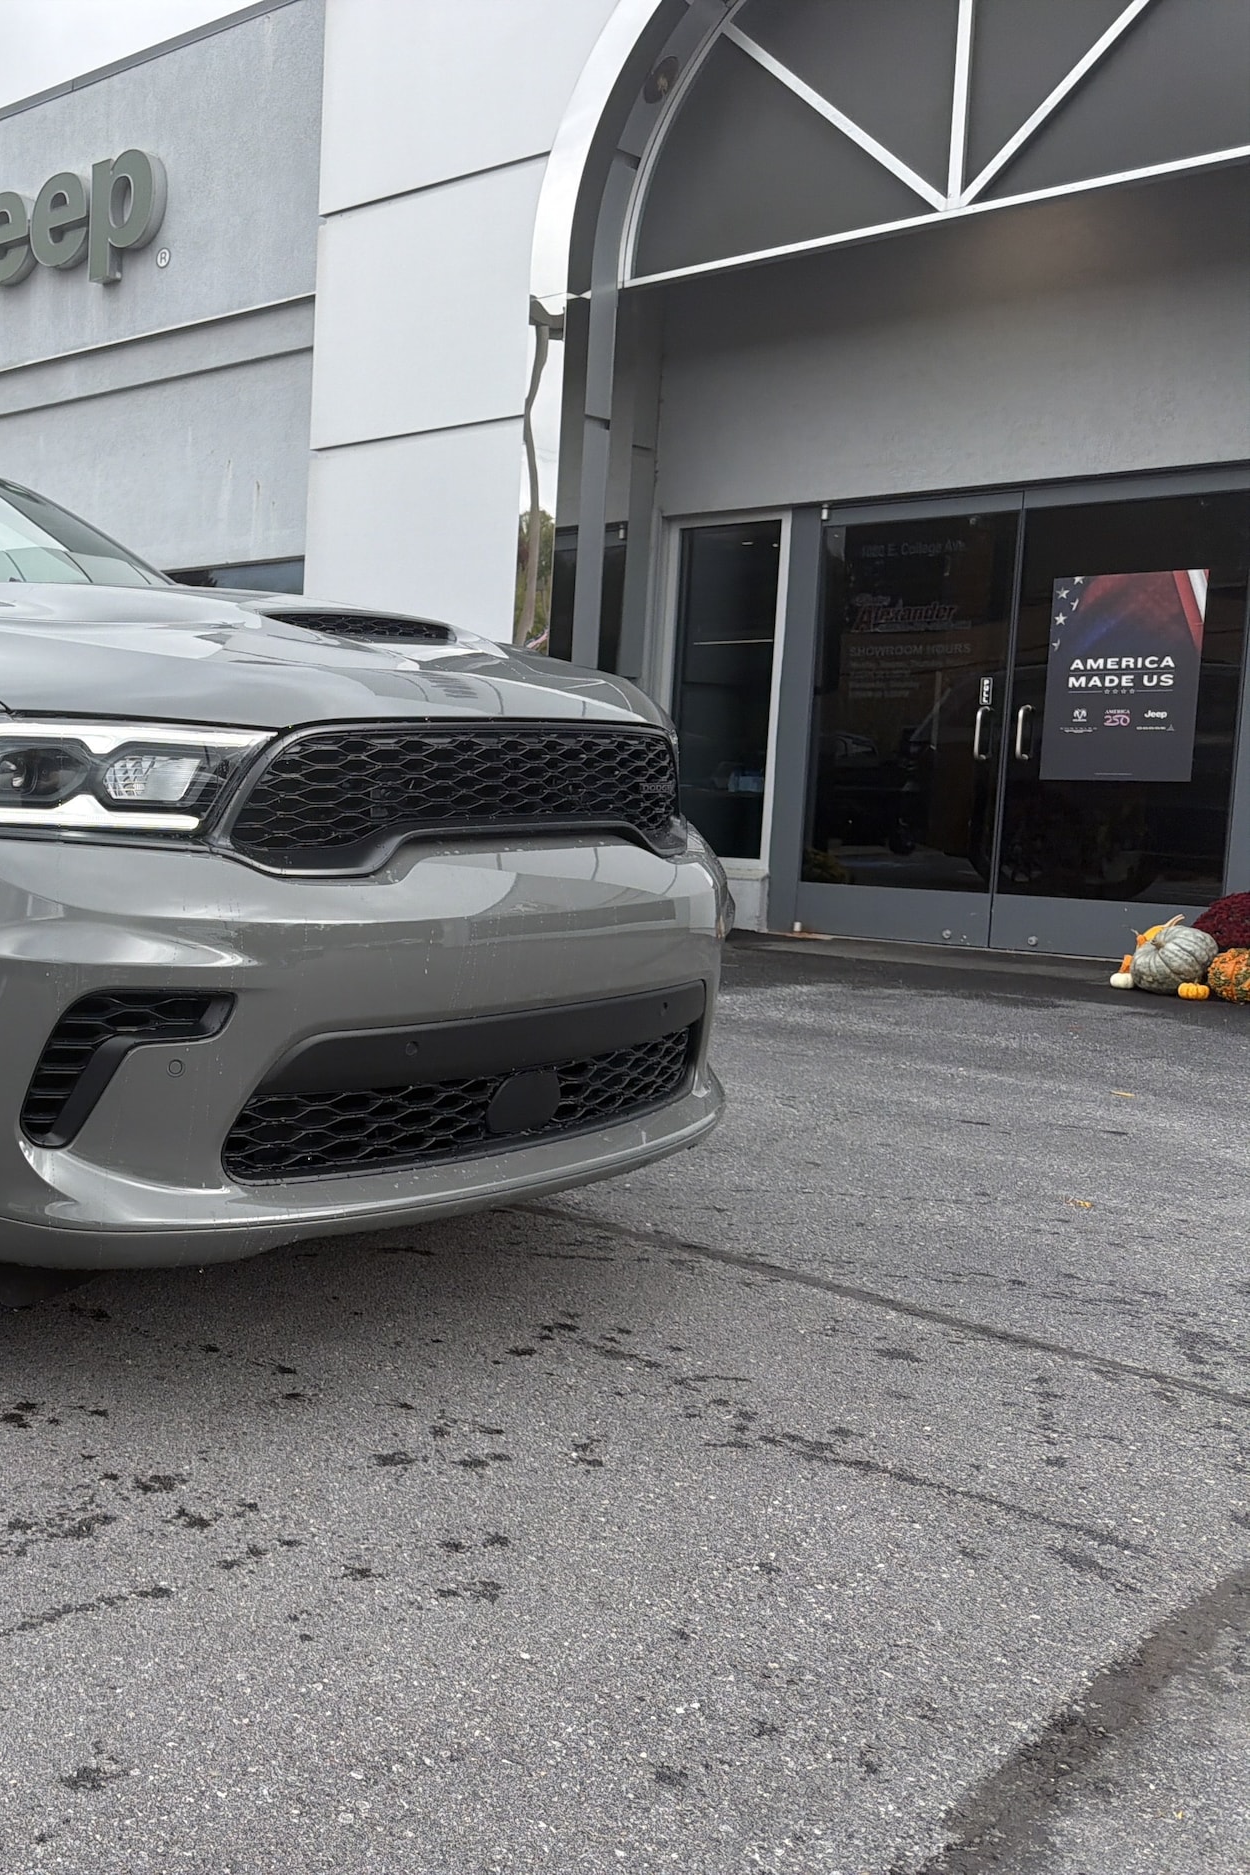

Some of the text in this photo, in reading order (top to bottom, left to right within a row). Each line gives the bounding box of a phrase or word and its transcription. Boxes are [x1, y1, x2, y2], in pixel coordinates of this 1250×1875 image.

[849, 643, 972, 657] SHOWROOM HOURS
[1070, 656, 1175, 670] AMERICA
[1068, 674, 1174, 688] MADE US
[982, 679, 990, 704] PULL
[1103, 715, 1130, 727] 250
[1144, 709, 1168, 719] Jeep
